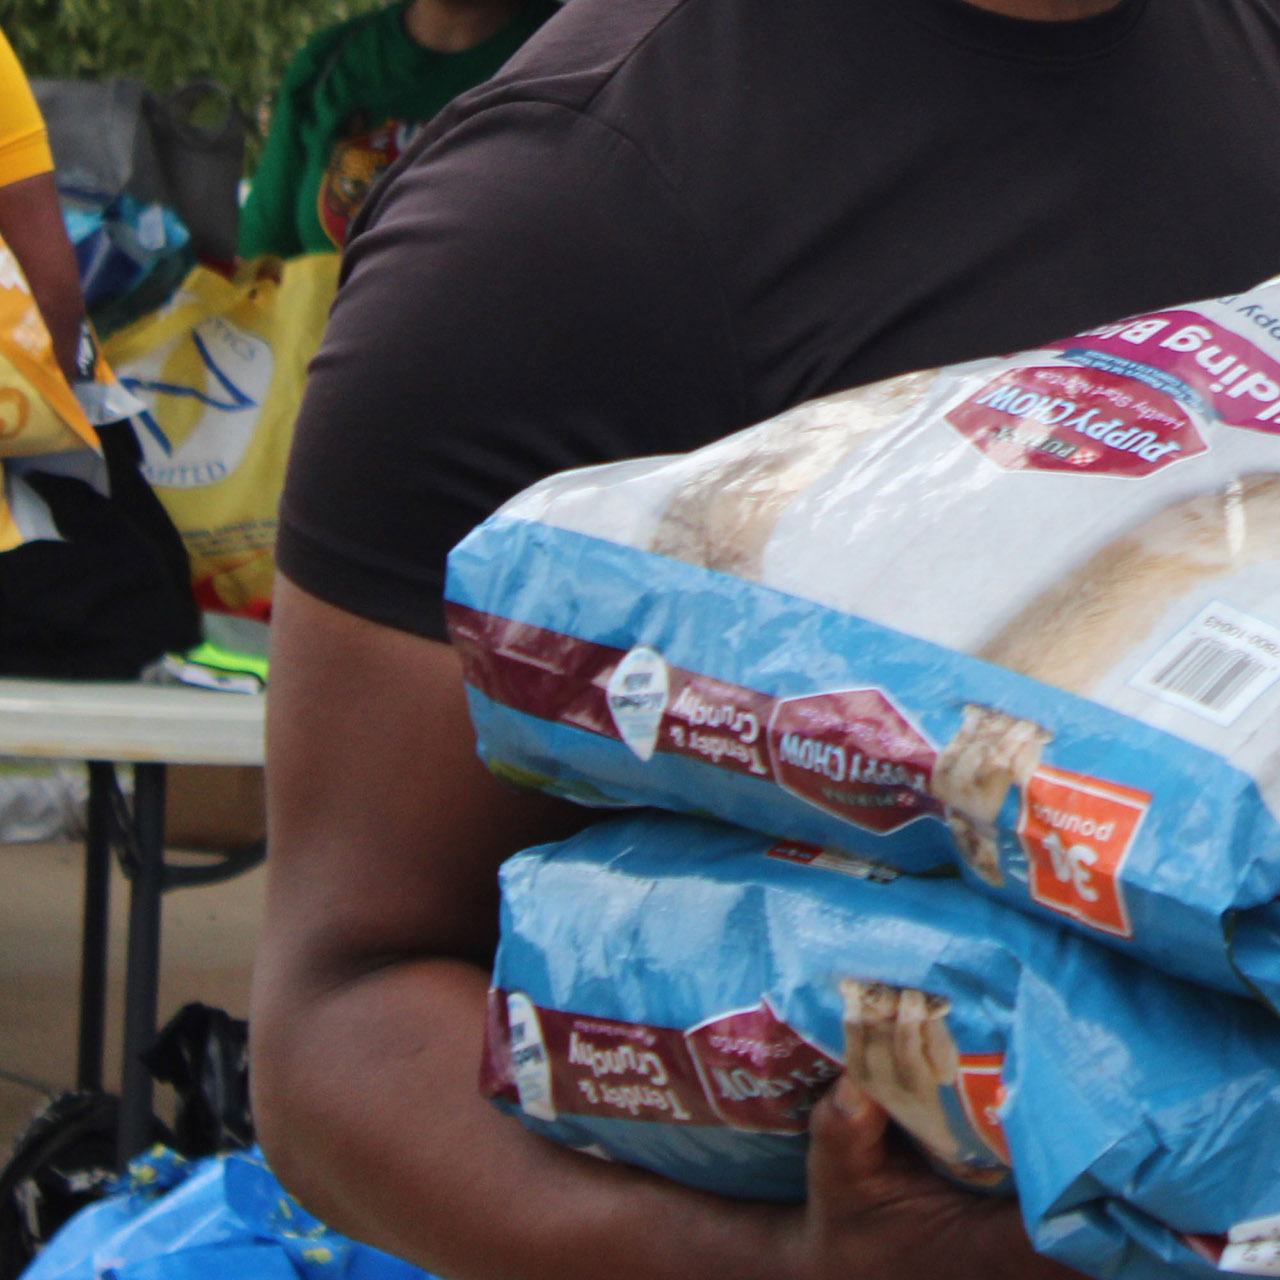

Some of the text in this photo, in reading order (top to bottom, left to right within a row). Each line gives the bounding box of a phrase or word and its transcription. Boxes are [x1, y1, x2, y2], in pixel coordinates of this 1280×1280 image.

[976, 384, 1073, 427] CHOW
[1071, 407, 1181, 463] PUPPY
[668, 724, 687, 748] &
[670, 686, 760, 744] Crunchy
[688, 728, 767, 775] Tender
[778, 732, 847, 782] CHOW
[1042, 832, 1100, 903] 34
